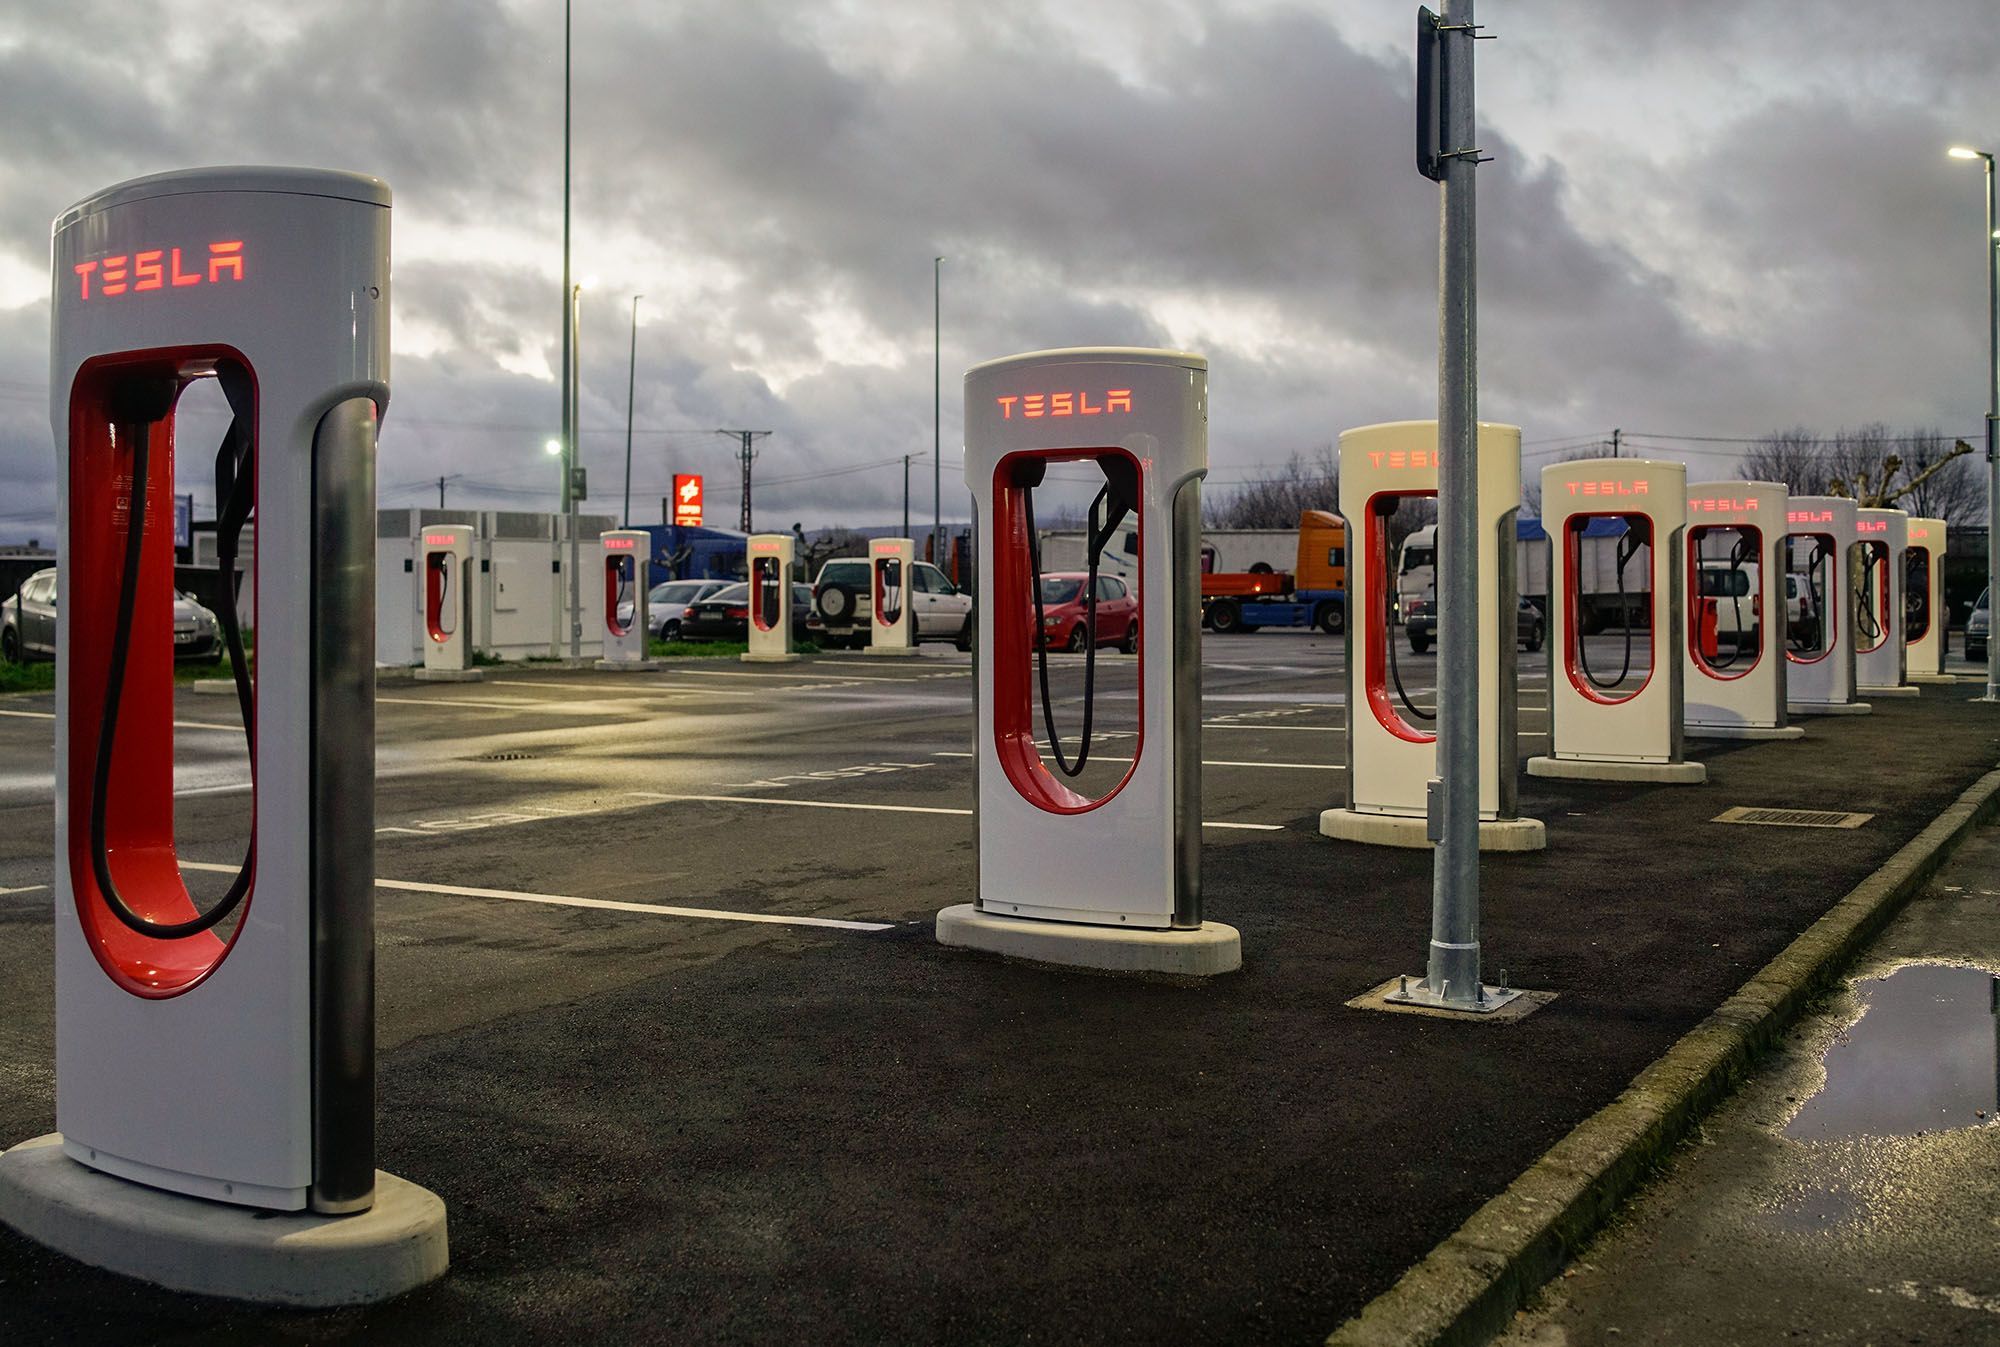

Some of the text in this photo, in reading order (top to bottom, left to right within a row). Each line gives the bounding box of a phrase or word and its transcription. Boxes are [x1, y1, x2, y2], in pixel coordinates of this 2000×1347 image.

[74, 240, 244, 301] TESLA
[997, 388, 1133, 419] TESLA
[1367, 449, 1440, 470] TESL
[1565, 480, 1649, 497] TESLA
[1688, 498, 1759, 513] TESLA
[1787, 510, 1833, 523] ESLA
[1855, 520, 1887, 533] SLA
